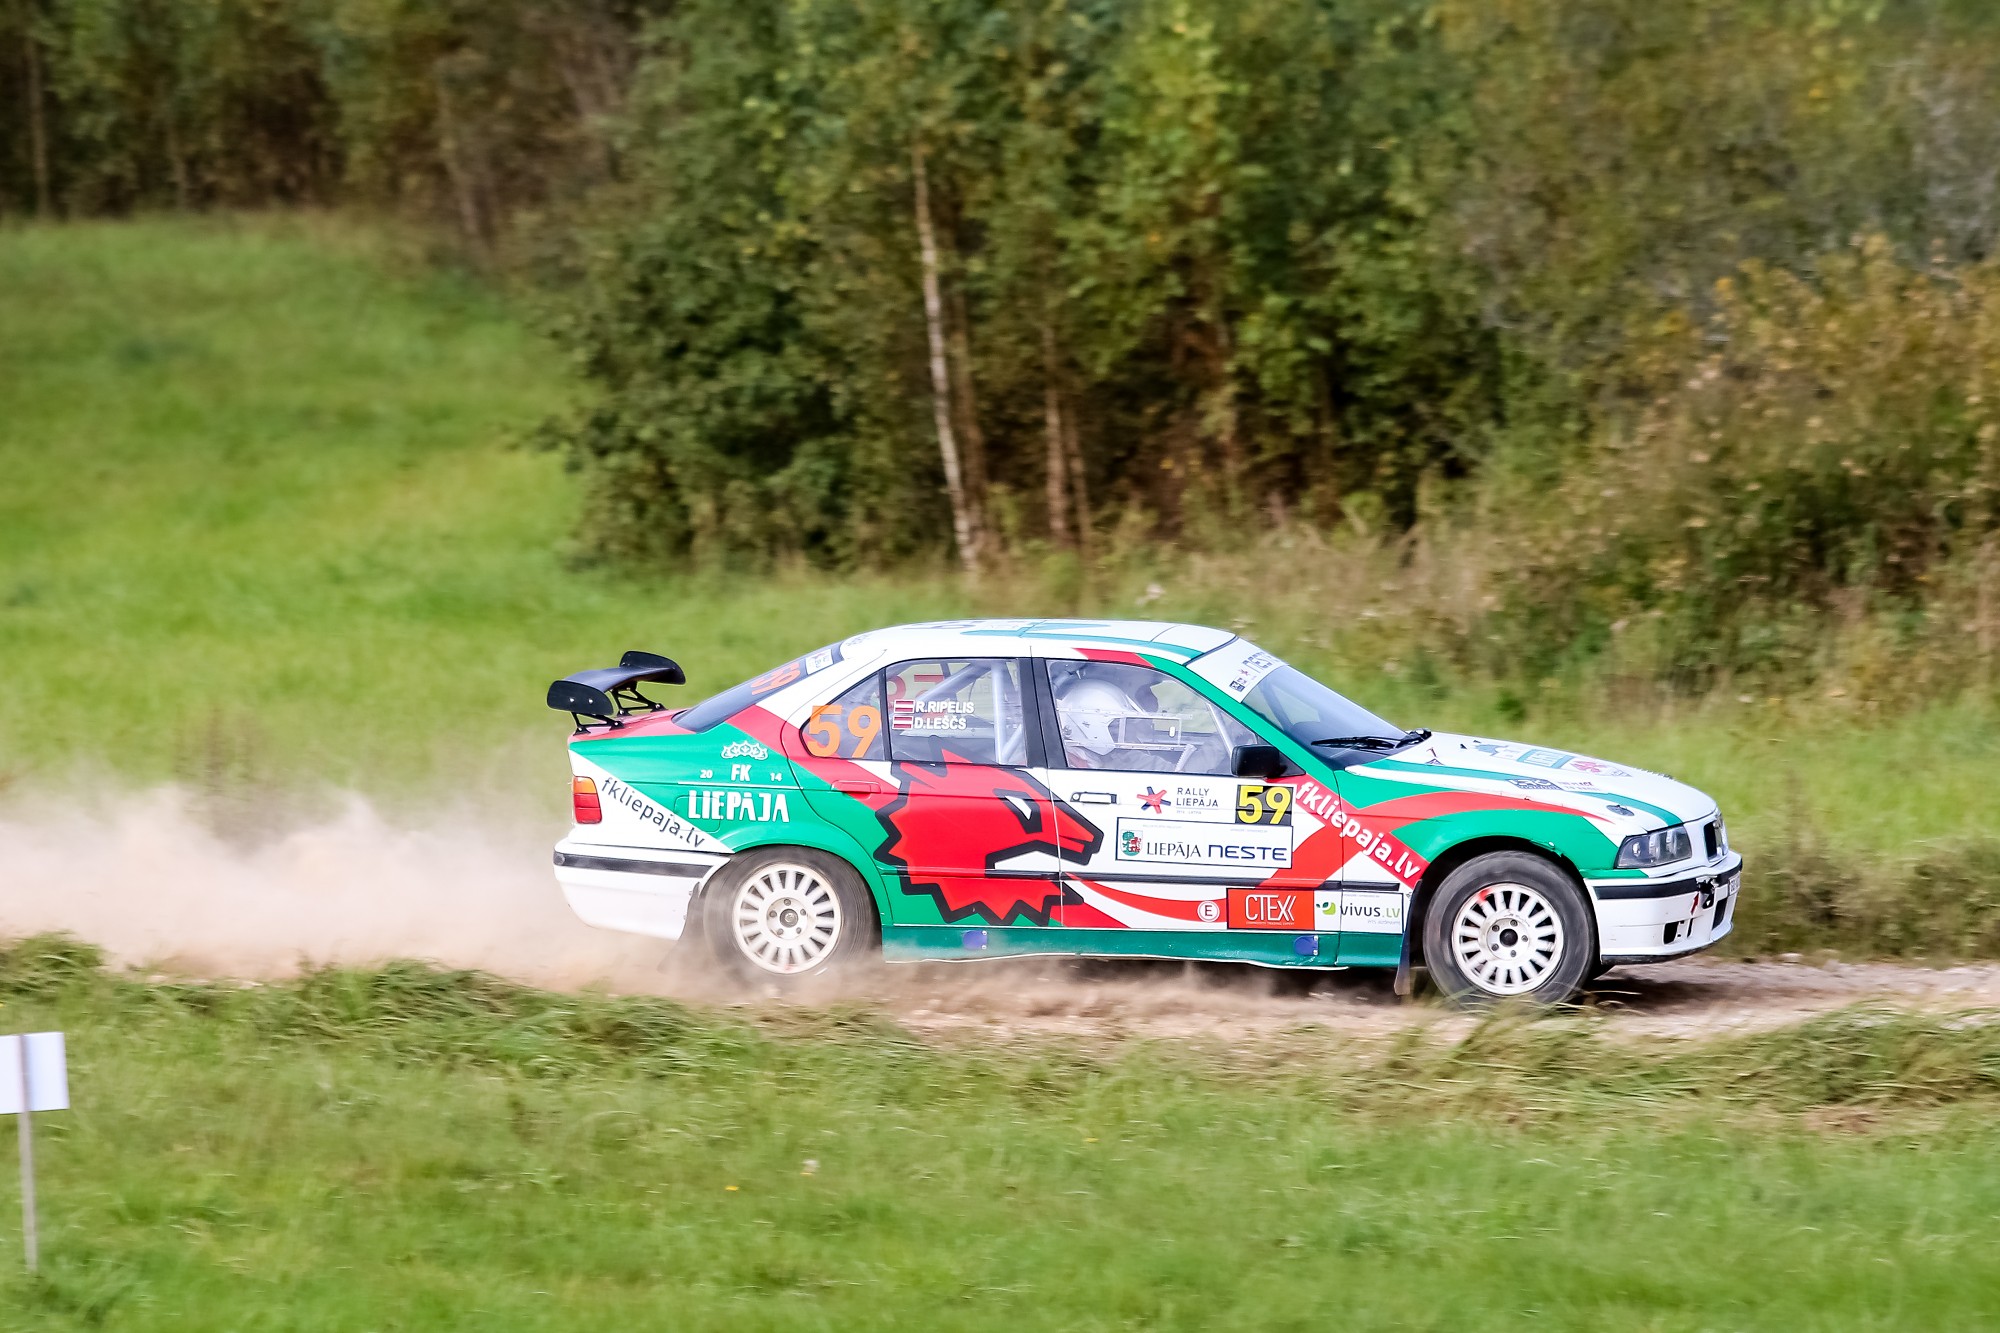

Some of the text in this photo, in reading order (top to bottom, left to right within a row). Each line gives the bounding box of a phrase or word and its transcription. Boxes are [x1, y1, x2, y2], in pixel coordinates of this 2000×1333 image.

[915, 701, 975, 714] R.RIPELIS
[914, 714, 967, 730] D.LEŠČS
[807, 705, 882, 759] 59
[700, 763, 783, 782] 20 FK 14
[1177, 787, 1210, 797] RALLY
[601, 776, 705, 848] fkliepaja.lv
[687, 790, 790, 823] LIEPĀJA
[1176, 797, 1219, 808] LIEPĀJA
[1236, 785, 1292, 825] 59
[1296, 781, 1421, 880] fkliepaja.lv
[1147, 841, 1201, 860] LIEPĀJA
[1208, 844, 1287, 861] NESTE
